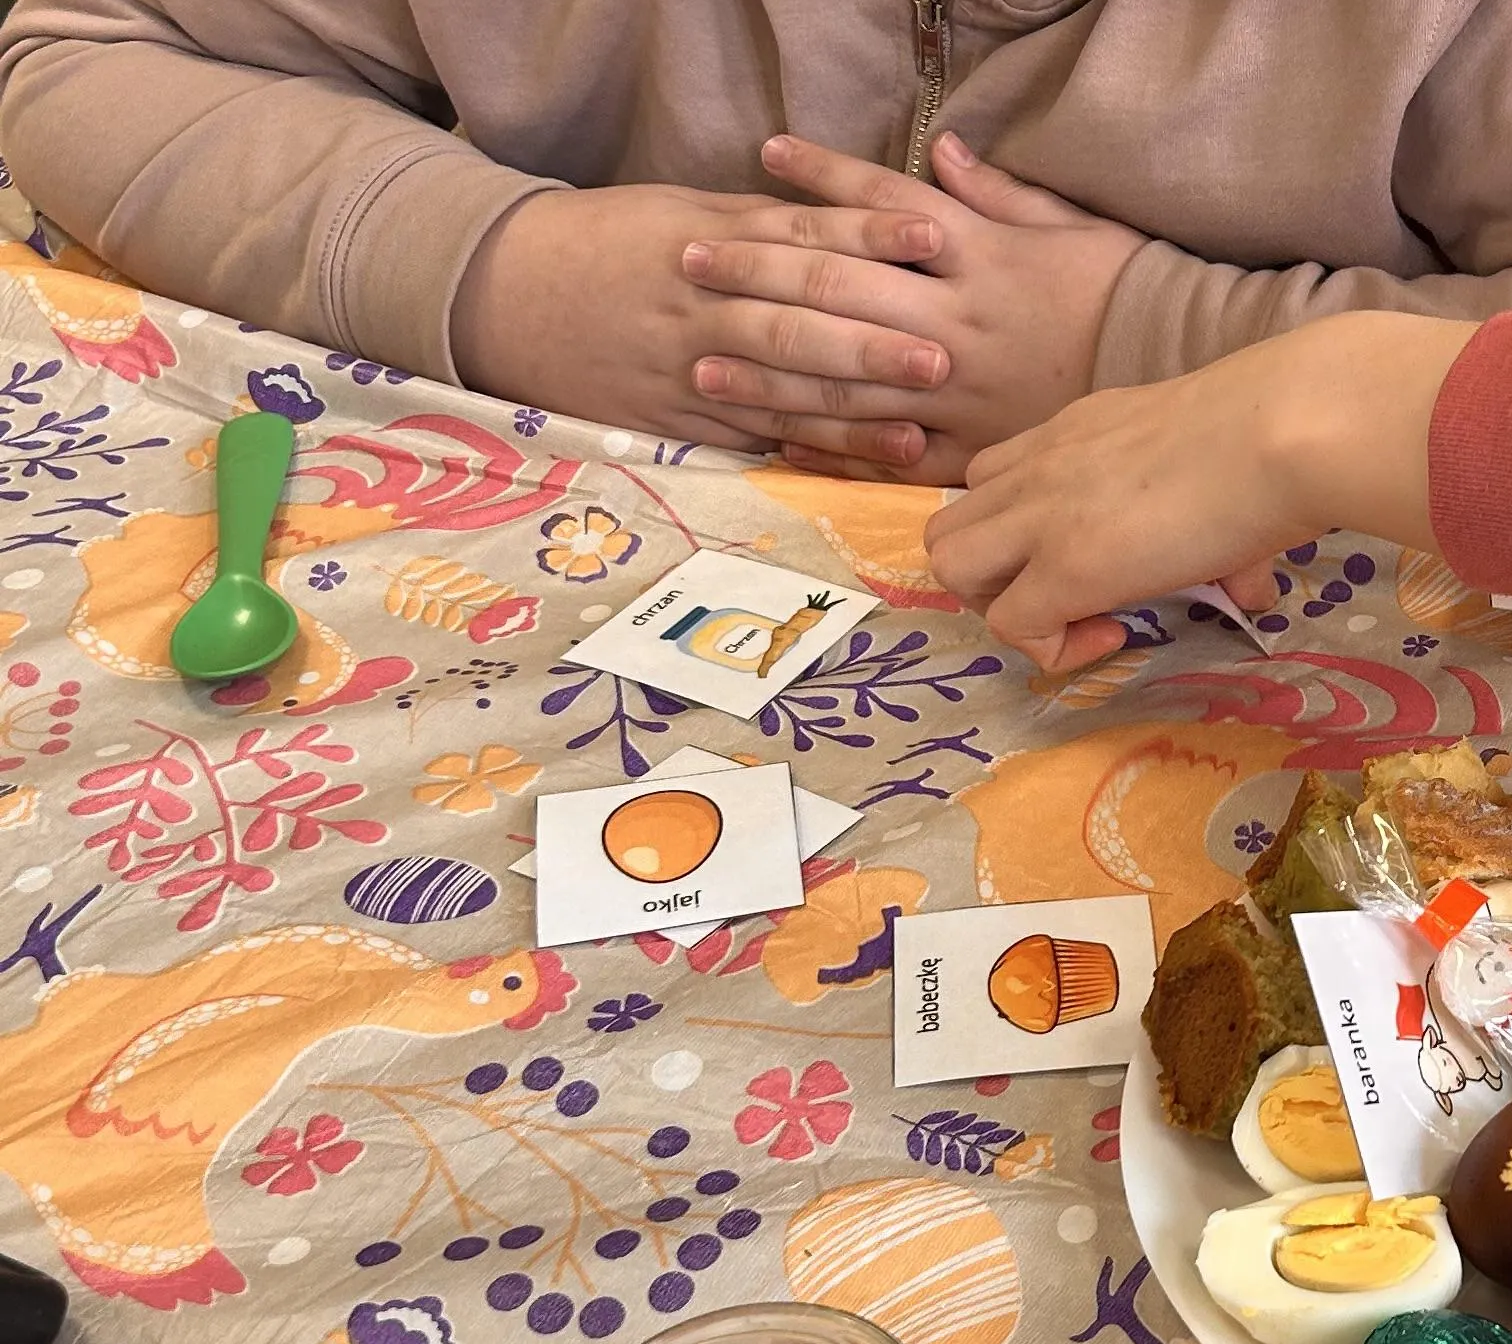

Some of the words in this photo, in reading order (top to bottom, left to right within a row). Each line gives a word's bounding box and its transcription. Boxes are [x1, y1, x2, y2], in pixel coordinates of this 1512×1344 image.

[630, 586, 684, 629] chrzan
[642, 889, 702, 915] jajko
[916, 957, 943, 1034] babeczkę
[1339, 999, 1380, 1105] baranka
